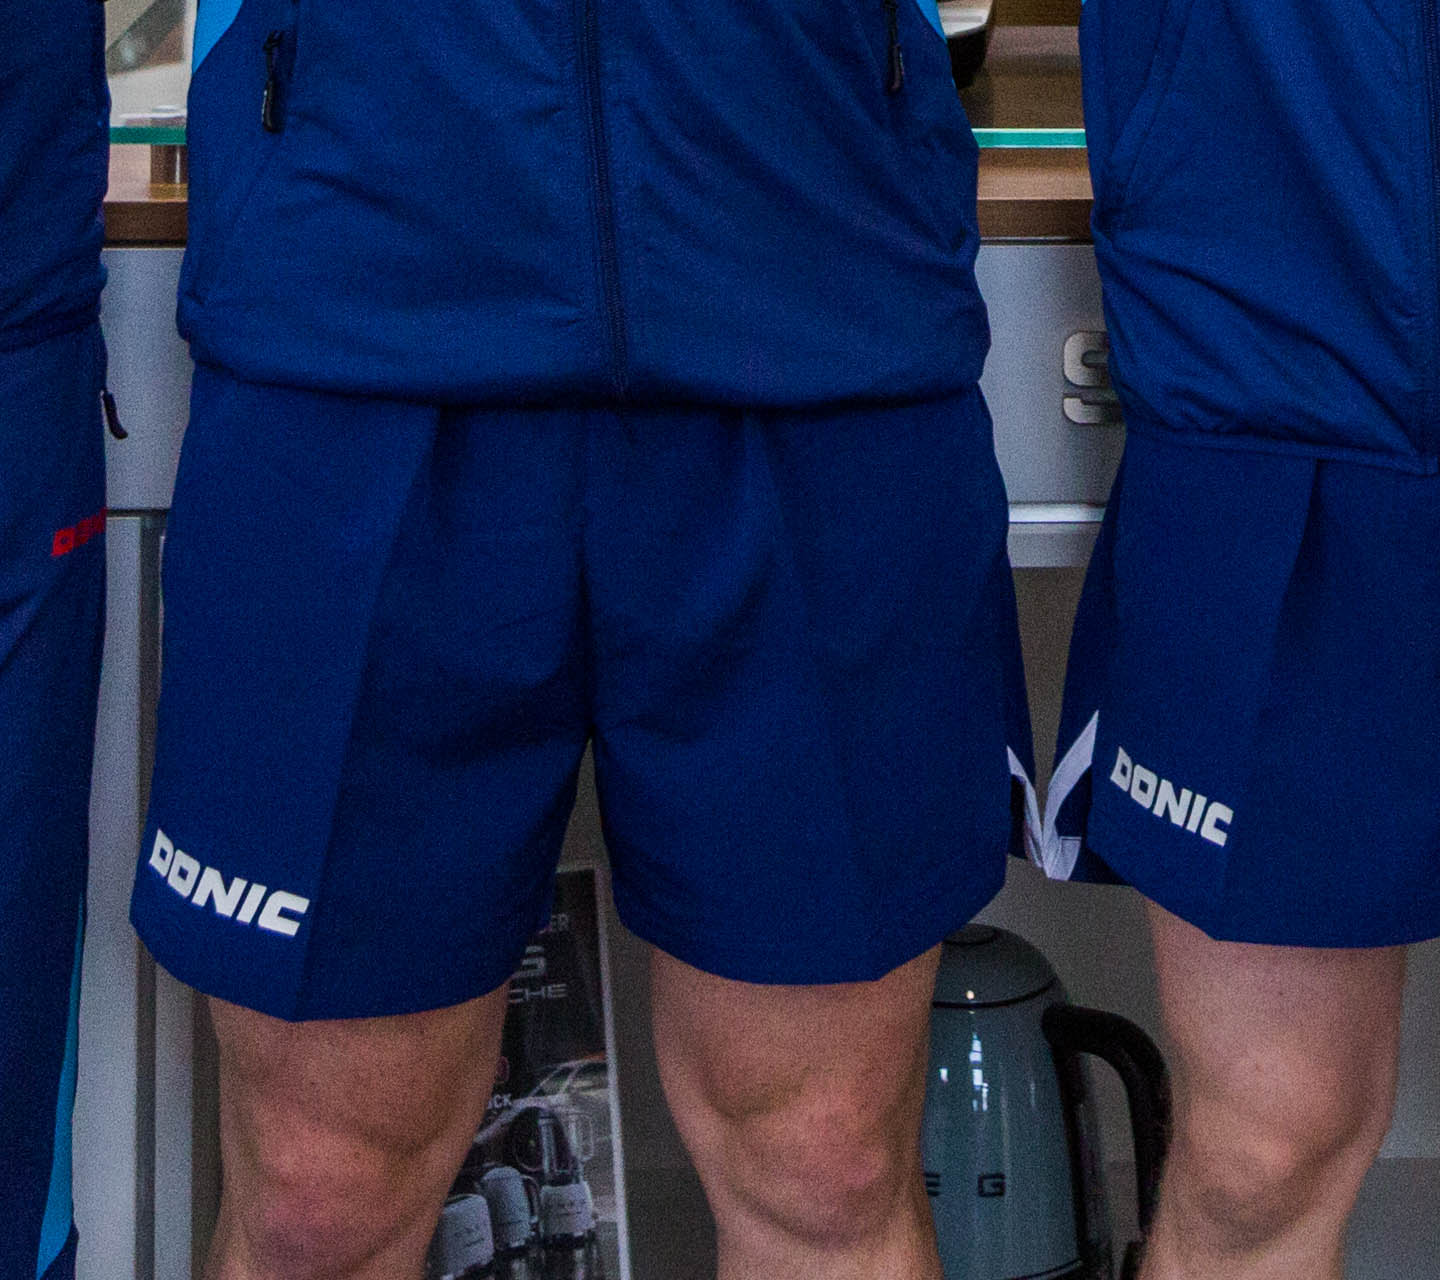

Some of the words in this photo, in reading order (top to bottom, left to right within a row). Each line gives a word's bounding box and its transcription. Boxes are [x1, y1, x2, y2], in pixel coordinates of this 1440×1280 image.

[1110, 746, 1234, 847] DONIC
[149, 828, 310, 937] DONIC
[508, 983, 568, 1003] CHE
